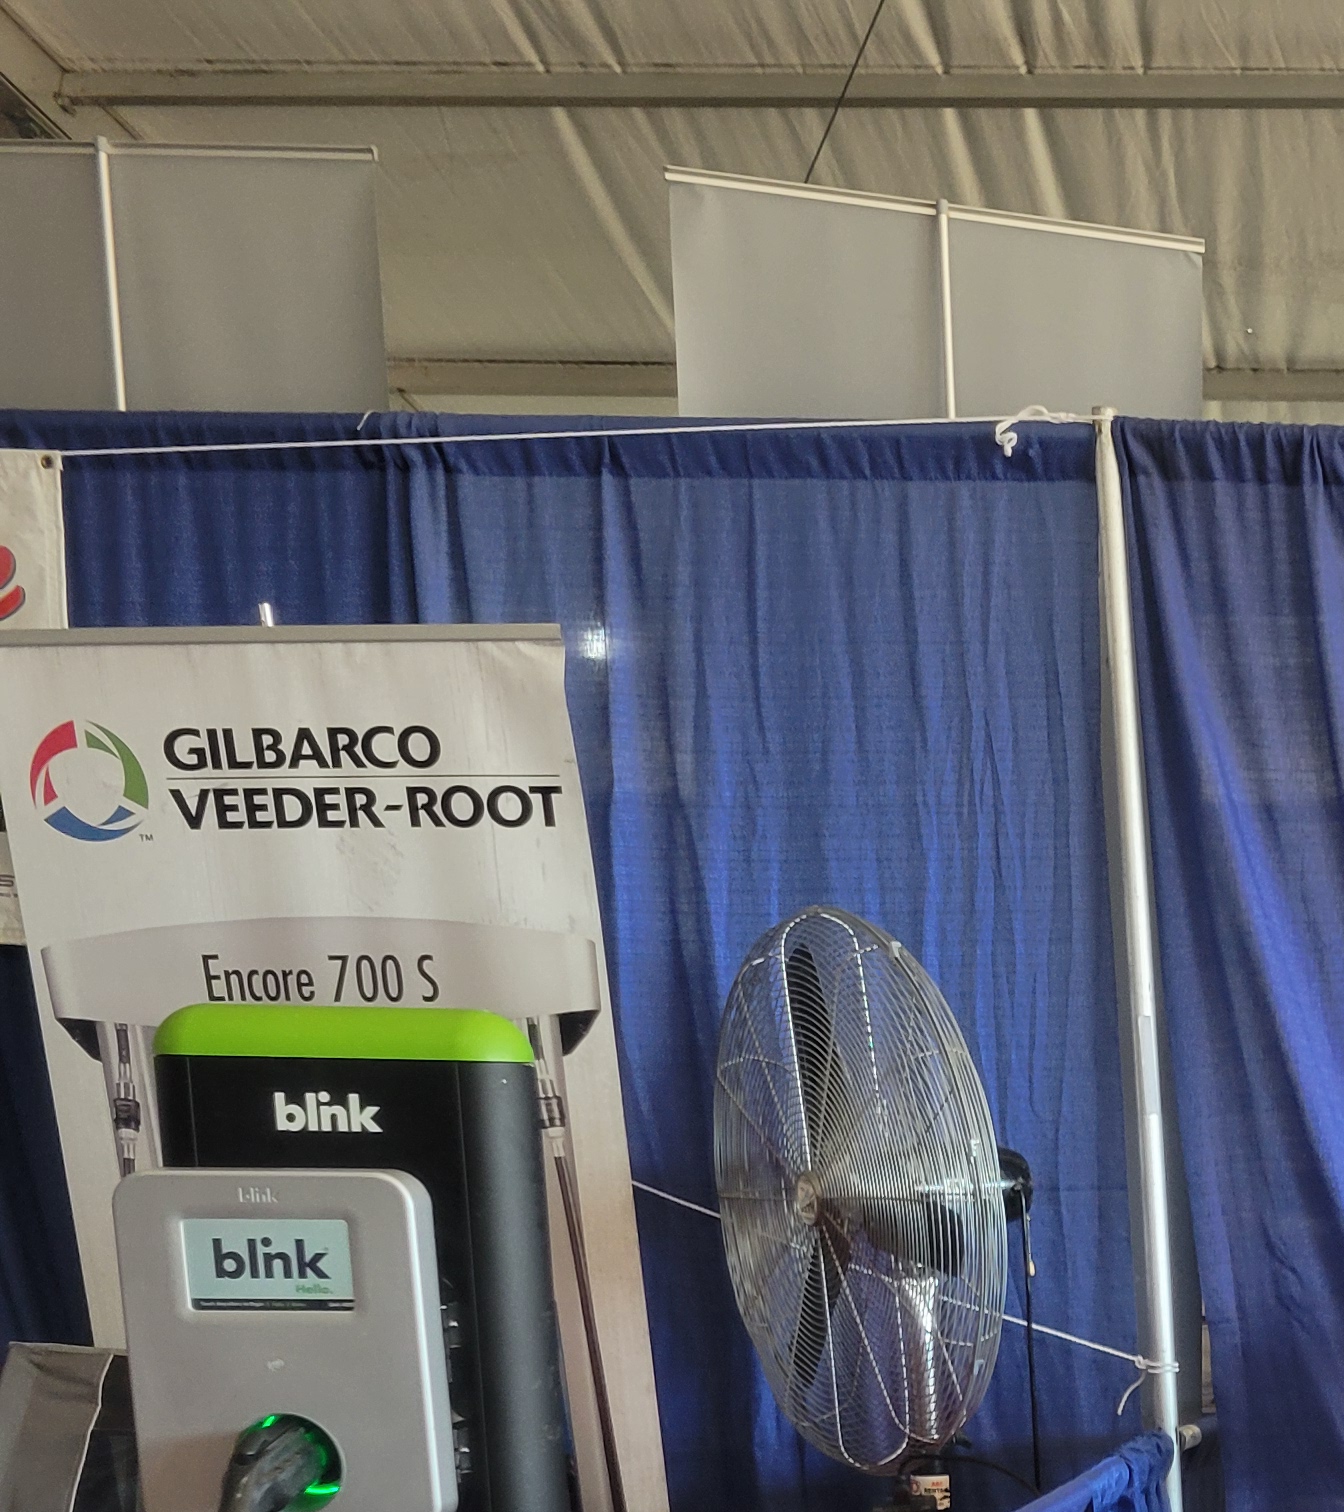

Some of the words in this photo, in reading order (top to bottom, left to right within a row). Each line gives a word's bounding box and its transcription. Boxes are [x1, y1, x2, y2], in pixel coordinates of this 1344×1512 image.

[163, 725, 442, 771] GILBARCO
[168, 785, 563, 831] VEEDER-ROOT
[201, 954, 316, 1002] Encore
[327, 954, 404, 1003] 700
[417, 954, 440, 1003] S
[273, 1092, 383, 1134] blink
[211, 1236, 332, 1280] blink
